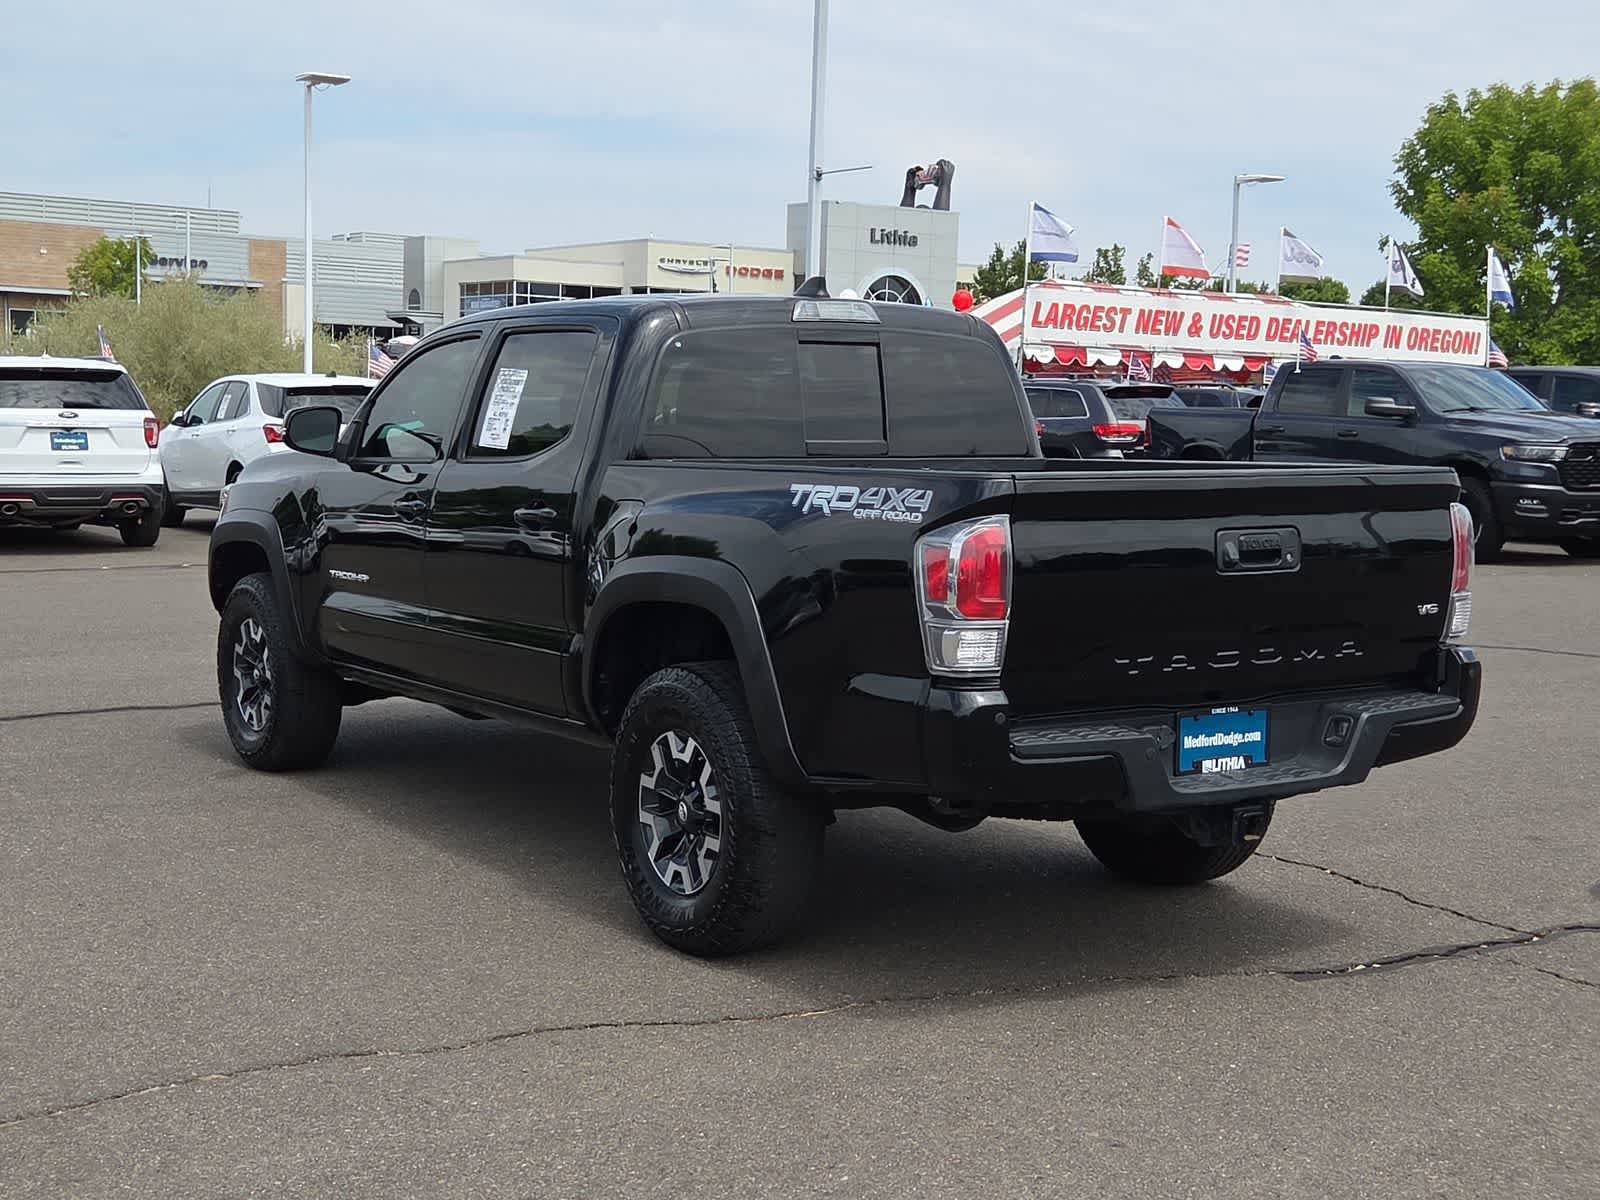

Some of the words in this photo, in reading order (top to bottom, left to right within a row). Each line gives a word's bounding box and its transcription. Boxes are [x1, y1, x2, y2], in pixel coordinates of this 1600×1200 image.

[870, 227, 918, 247] Lithia
[725, 265, 785, 280] DODGE
[1031, 301, 1132, 333] LARGEST
[1135, 308, 1185, 337] NEW
[1186, 311, 1204, 338] &
[1208, 313, 1261, 341] USED
[1265, 317, 1380, 348] DEALERSHIP
[1383, 324, 1403, 350] IN
[1406, 326, 1482, 355] OREGON!
[853, 508, 882, 519] OFF
[882, 510, 923, 524] ROAD
[1417, 603, 1439, 615] V6
[1114, 641, 1364, 675] TACOMA
[1183, 731, 1261, 749] MedfordDodge.com
